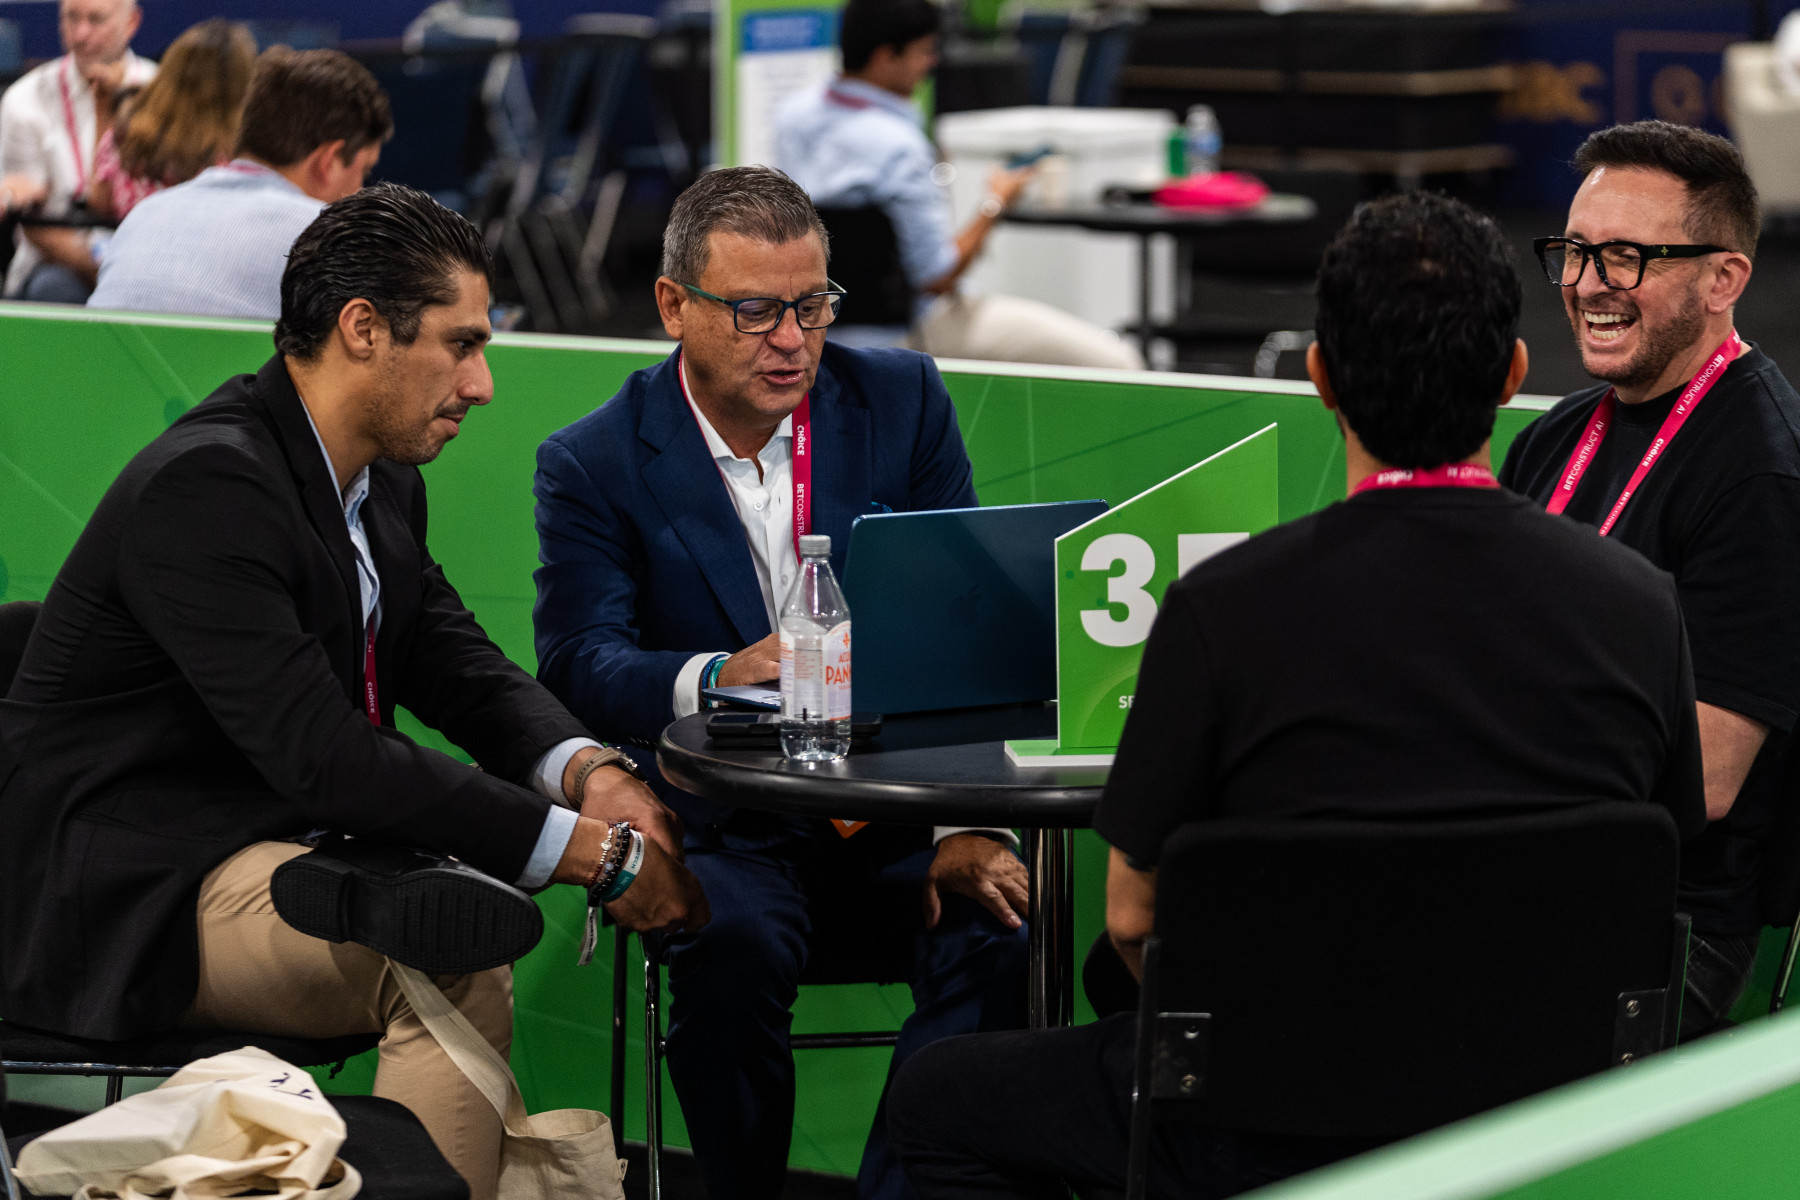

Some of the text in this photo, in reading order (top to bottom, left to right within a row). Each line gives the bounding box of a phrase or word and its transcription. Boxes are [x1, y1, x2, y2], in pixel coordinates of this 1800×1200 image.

[1676, 354, 1725, 415] BETCONSTRUCT AI
[1563, 420, 1605, 491] BETCONSTRUCT AI
[1599, 491, 1630, 536] BETCONSTR
[825, 663, 851, 686] PAN
